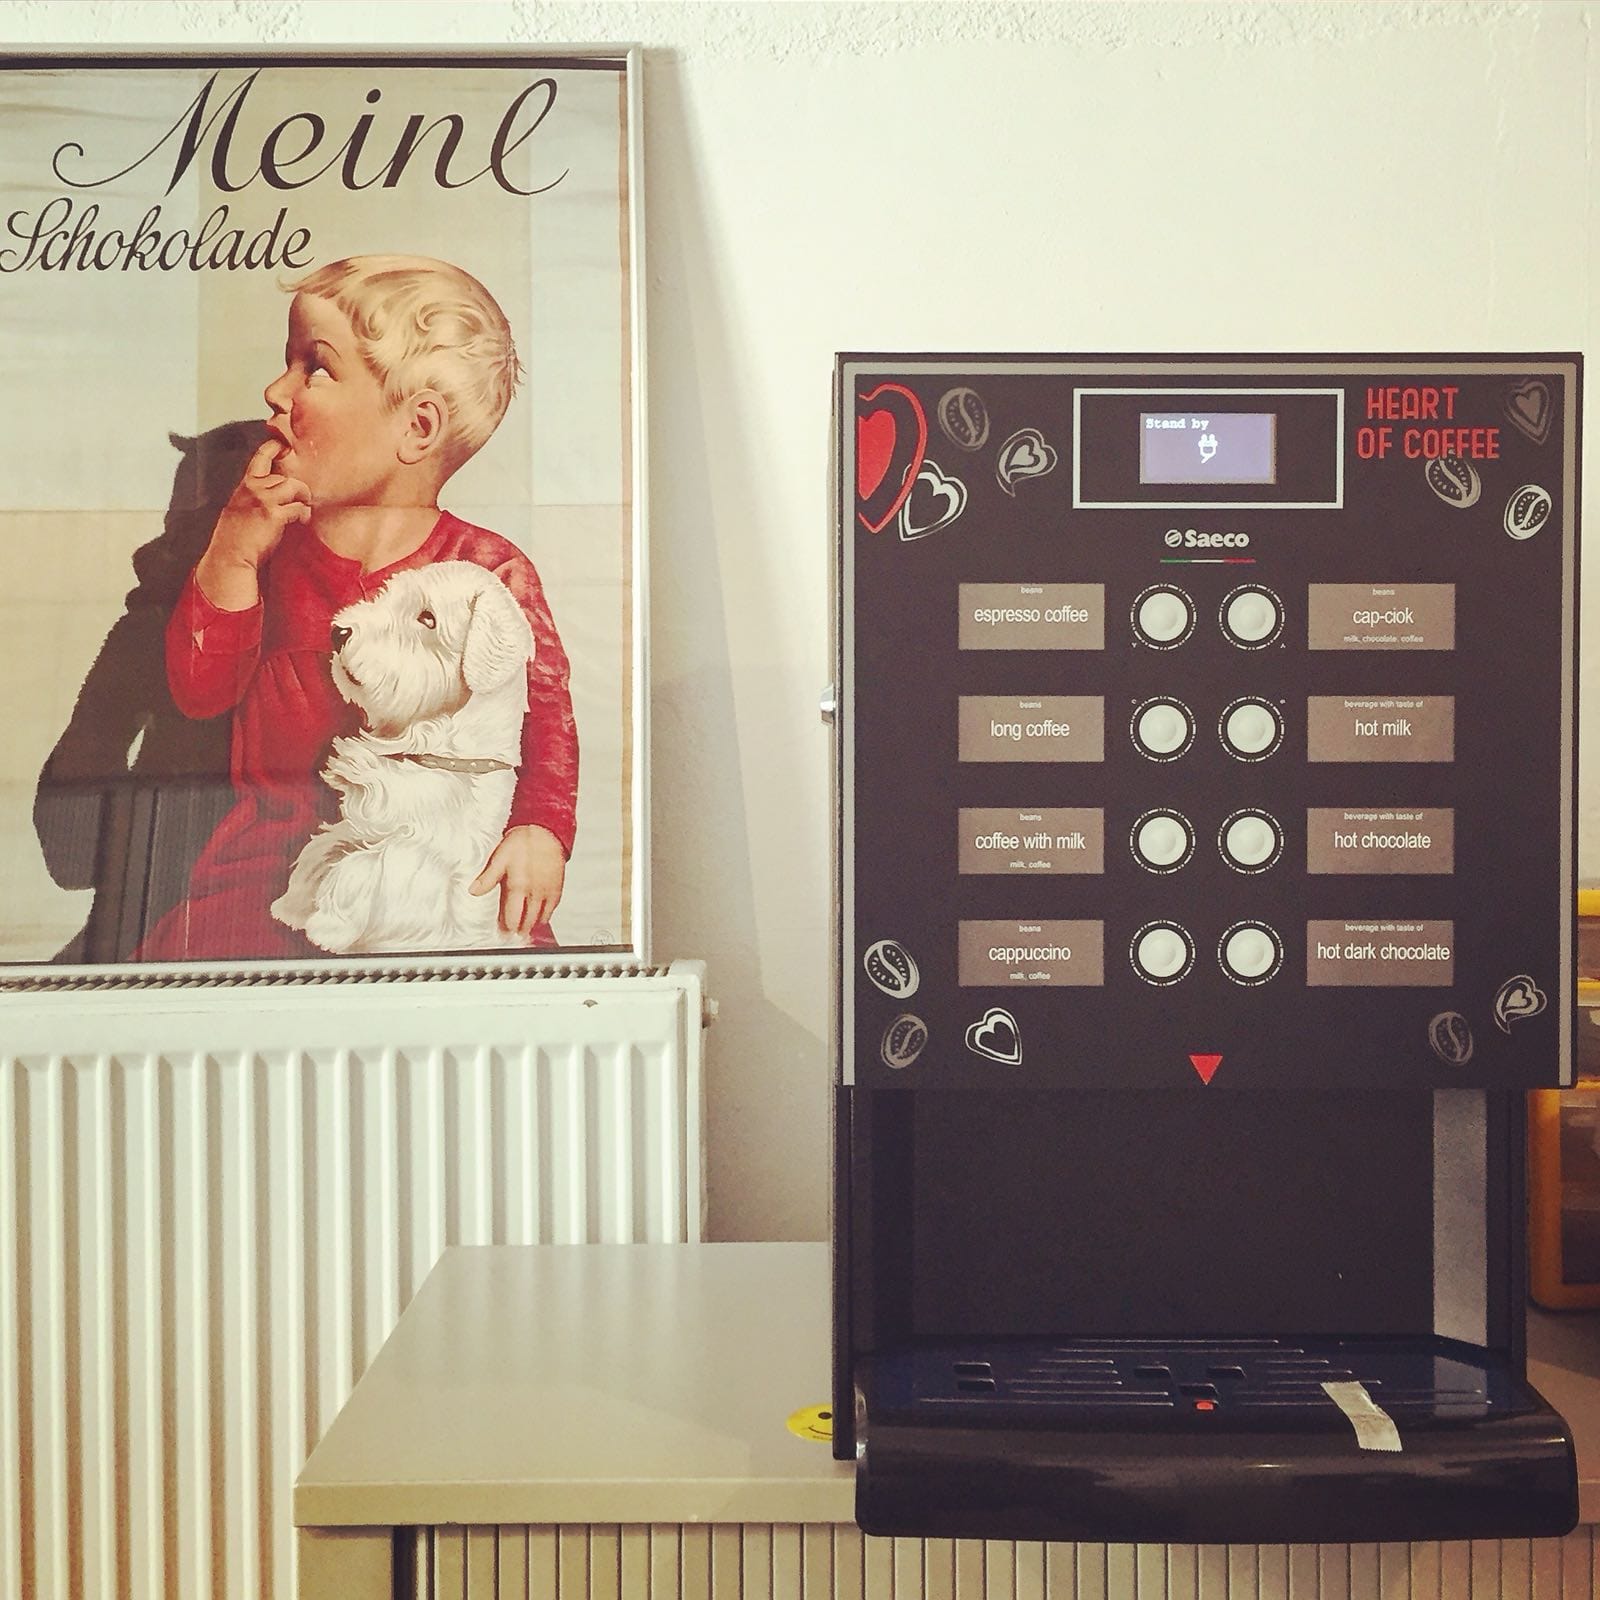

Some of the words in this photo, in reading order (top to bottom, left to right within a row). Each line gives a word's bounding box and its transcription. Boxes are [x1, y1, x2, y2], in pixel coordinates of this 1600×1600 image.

[52, 67, 570, 196] Meinl
[0, 198, 314, 273] Schokolade
[1367, 386, 1460, 420] HEART
[1145, 418, 1186, 429] Stand
[1191, 418, 1209, 431] by
[1357, 426, 1393, 460] OF
[1403, 427, 1500, 460] COFFEE
[1184, 529, 1250, 548] Saeco
[1020, 586, 1043, 594] beans
[1372, 588, 1395, 596] beans
[974, 608, 1040, 626] espresso
[1044, 605, 1089, 622] coffee
[1353, 607, 1414, 628] cap-ciok
[1400, 635, 1424, 643] coffee
[1020, 701, 1042, 709] beans
[1344, 701, 1378, 709] beverage
[990, 720, 1022, 741] long
[1025, 720, 1070, 737] coffee
[1355, 719, 1379, 736] hot
[1382, 719, 1412, 736] milk
[1344, 812, 1378, 821] beverage
[1379, 812, 1395, 820] with
[1395, 812, 1414, 820] taste
[1415, 812, 1424, 820] of
[975, 832, 1020, 849] coffee
[1023, 832, 1052, 849] with
[1056, 832, 1086, 849] milk
[1334, 831, 1358, 848] hot
[1361, 831, 1432, 849] chocolate
[1019, 925, 1042, 933] beans
[1345, 924, 1379, 933] beverage
[1380, 924, 1395, 932] with
[1396, 924, 1415, 932] taste
[1416, 924, 1424, 932] of
[988, 943, 1072, 964] cappuccino
[1317, 942, 1341, 959] hot
[1344, 942, 1376, 959] dark
[1380, 942, 1450, 960] chocolate
[1028, 972, 1052, 980] coffee
